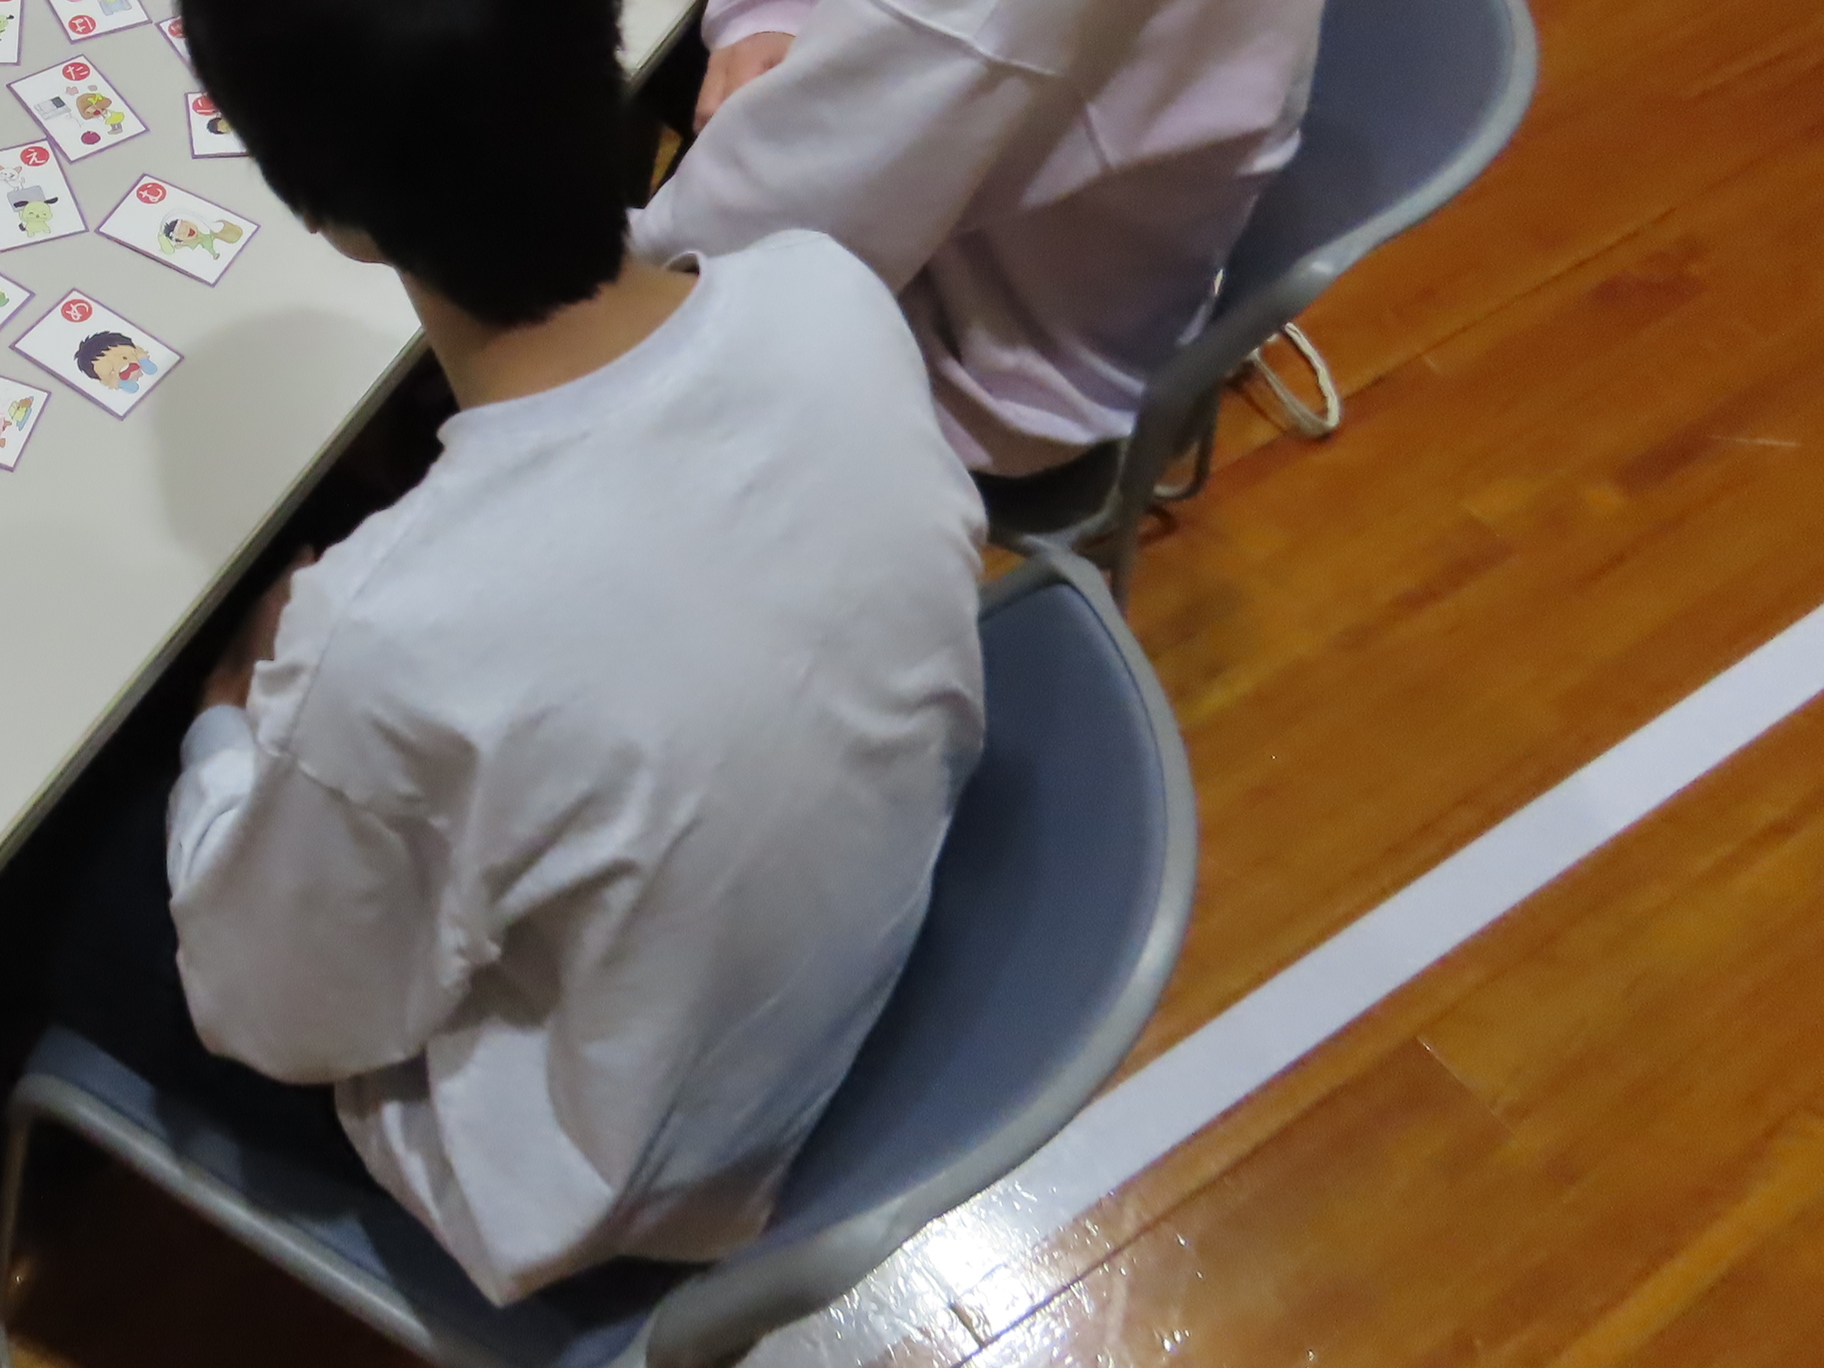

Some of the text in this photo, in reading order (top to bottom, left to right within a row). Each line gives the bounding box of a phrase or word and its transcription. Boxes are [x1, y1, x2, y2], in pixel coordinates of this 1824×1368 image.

[71, 16, 94, 34] は
[66, 65, 89, 80] た
[25, 148, 46, 165] え
[138, 183, 164, 203] む
[65, 302, 90, 321] め
